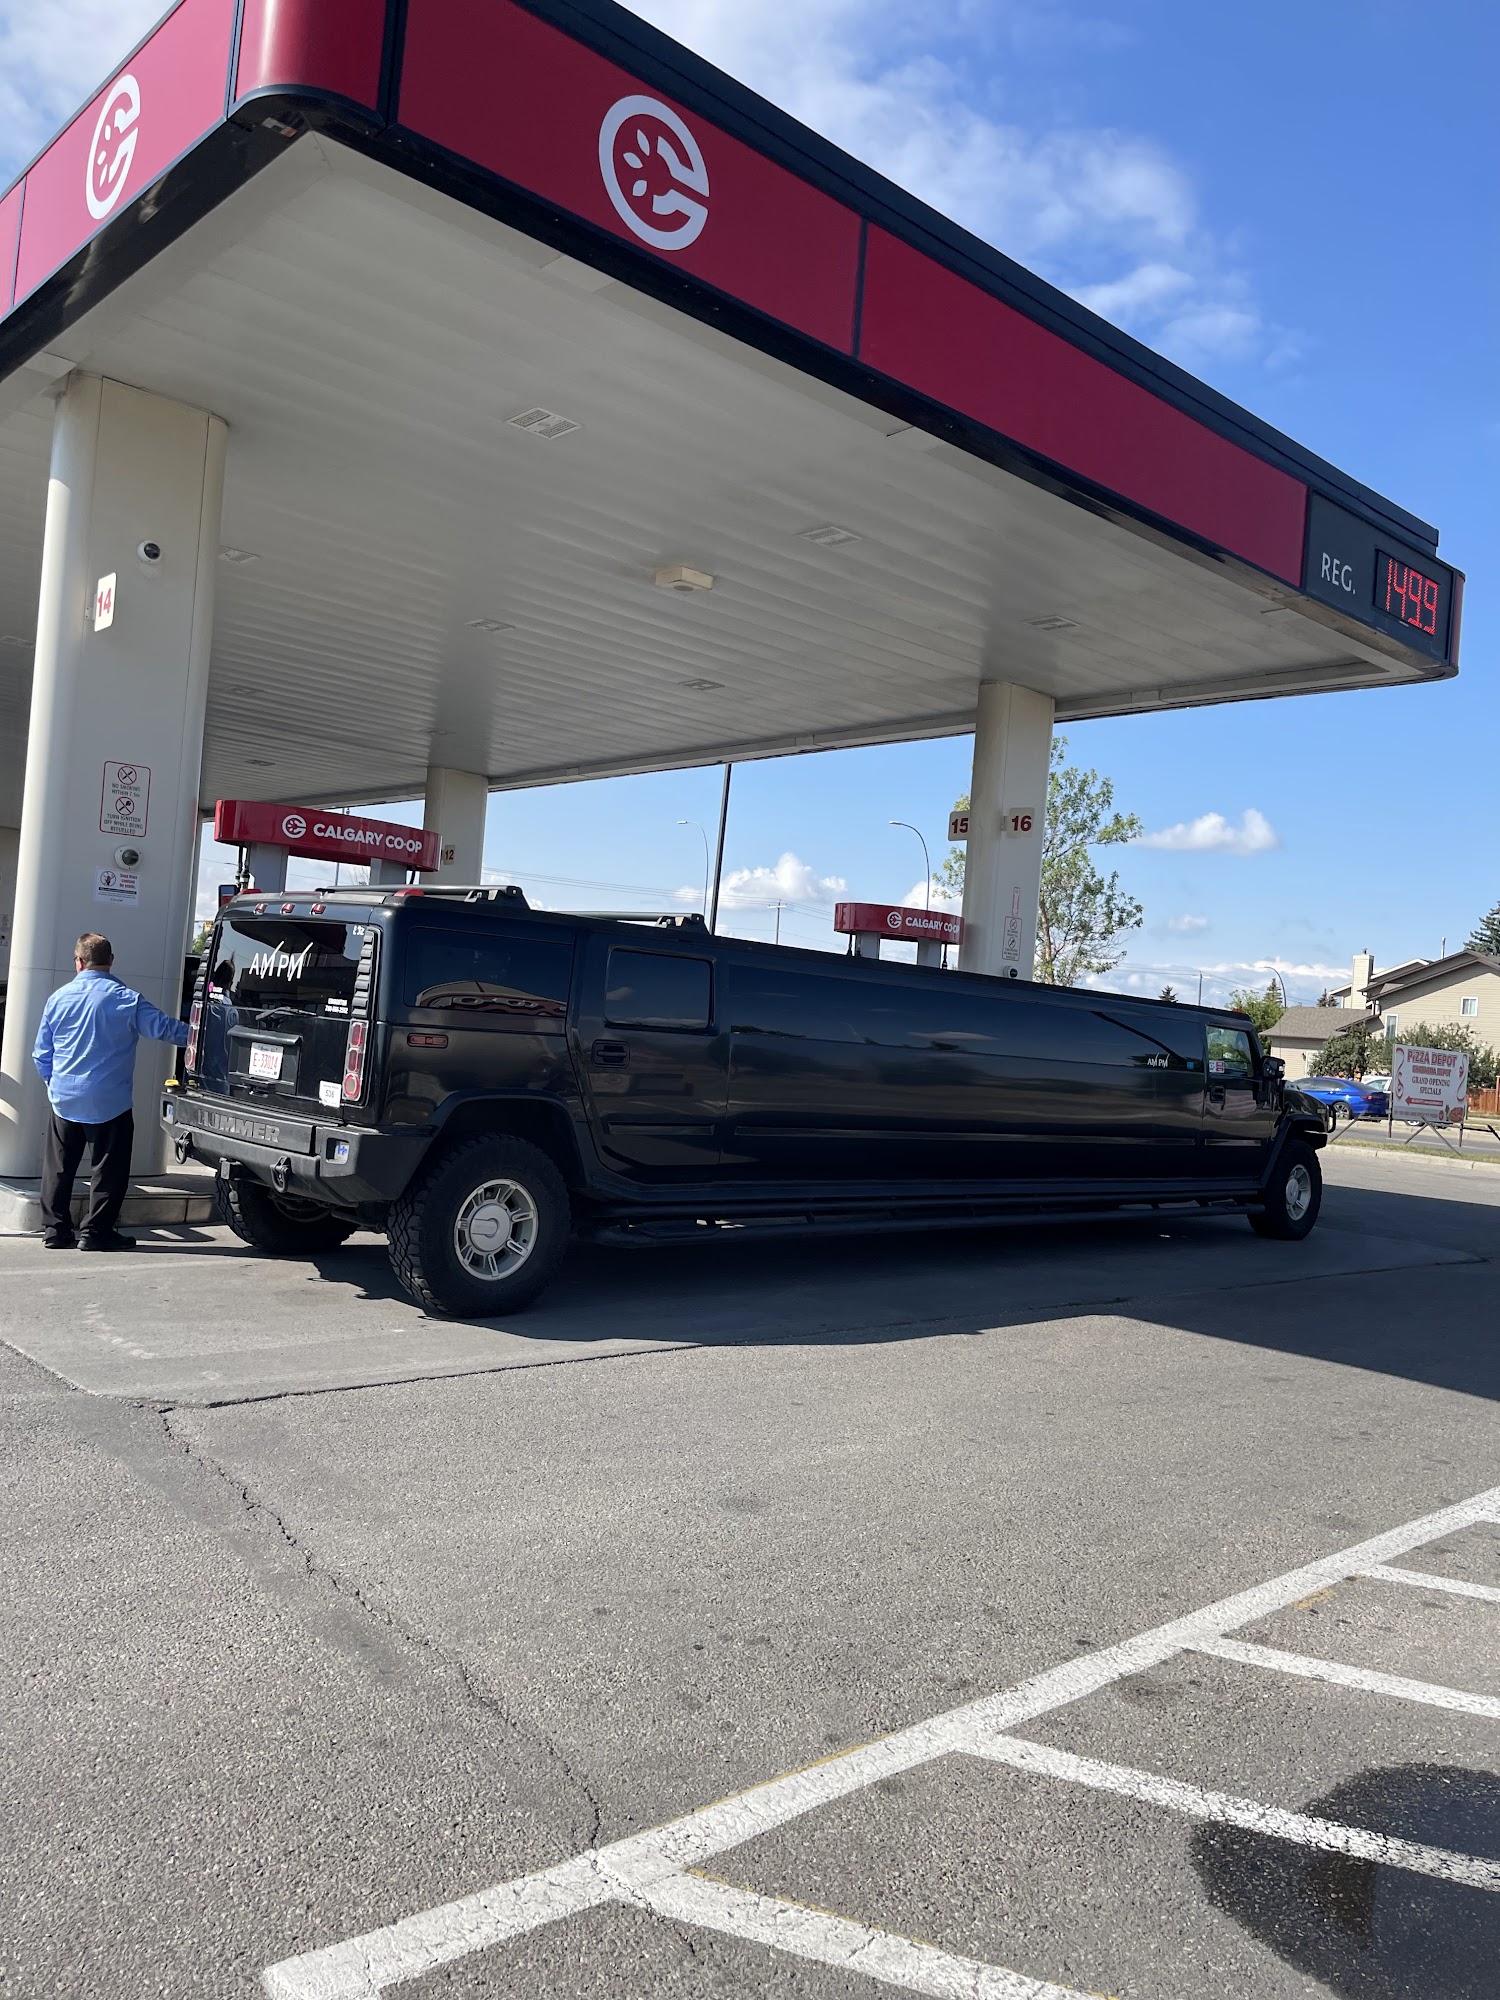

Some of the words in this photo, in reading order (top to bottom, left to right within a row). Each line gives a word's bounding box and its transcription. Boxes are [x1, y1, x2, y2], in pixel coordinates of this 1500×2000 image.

[1321, 552, 1356, 595] REG.
[97, 587, 112, 618] 14
[120, 784, 141, 792] SMOKING
[113, 820, 128, 828] WHILE
[129, 822, 143, 830] BEING
[120, 814, 141, 823] IGNITION
[951, 817, 969, 834] 15
[1011, 815, 1032, 832] 16
[313, 823, 383, 845] CALGARY
[445, 849, 454, 860] 12
[905, 916, 943, 930] CALGARY
[248, 940, 285, 979] AM
[277, 941, 314, 982] PM
[1146, 1053, 1159, 1067] AM
[1158, 1053, 1170, 1068] PM
[1431, 1052, 1457, 1068] DEPOT
[1412, 1076, 1428, 1085] GRAND
[1429, 1078, 1450, 1087] OPENING
[1419, 1086, 1442, 1095] SPECIALS
[197, 1109, 280, 1143] HUMMER
